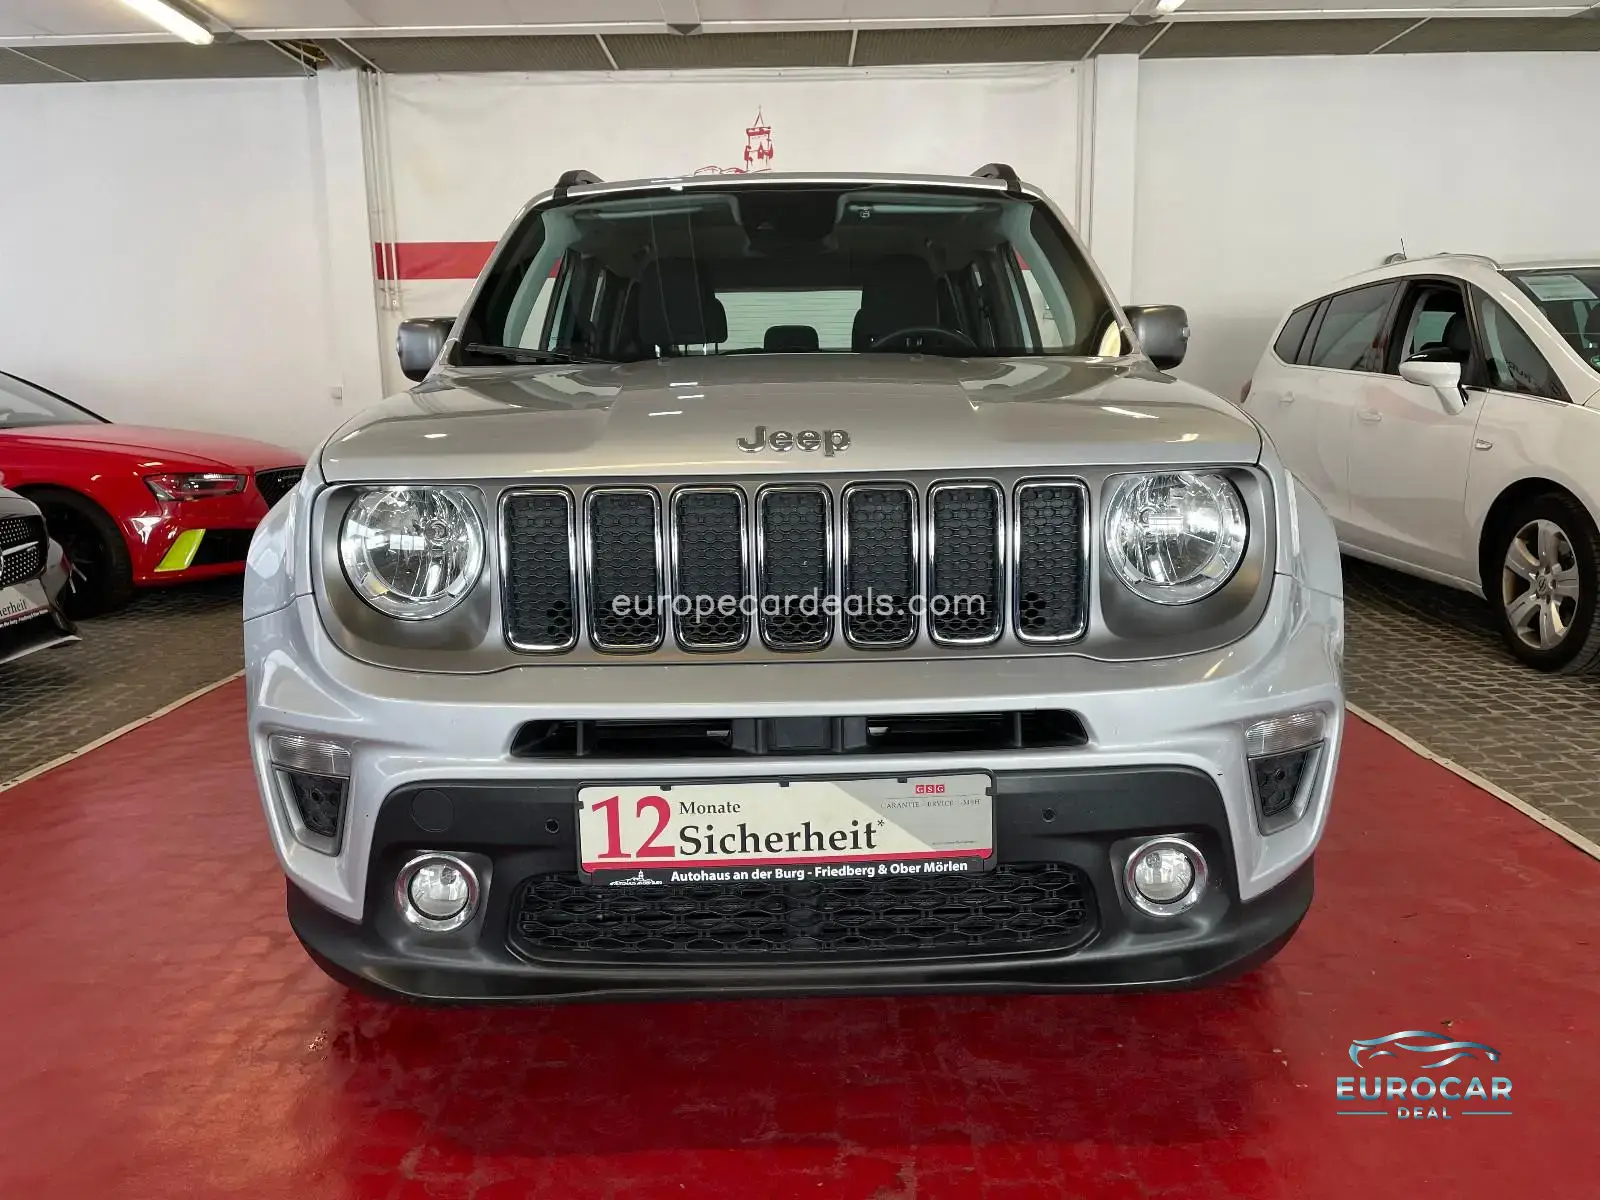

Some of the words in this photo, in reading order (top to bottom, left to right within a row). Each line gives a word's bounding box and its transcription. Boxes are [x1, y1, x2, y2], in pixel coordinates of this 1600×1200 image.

[736, 425, 852, 457] Jeep
[915, 784, 945, 793] GSG
[679, 800, 741, 815] Monate
[591, 795, 676, 859] 12
[670, 870, 731, 882] Autohaus
[732, 871, 749, 881] an
[751, 869, 772, 880] der
[775, 868, 805, 881] Burg
[814, 865, 876, 878] Friedberg
[877, 864, 887, 875] &
[890, 863, 920, 874] Ober
[923, 860, 968, 872] Mörlen
